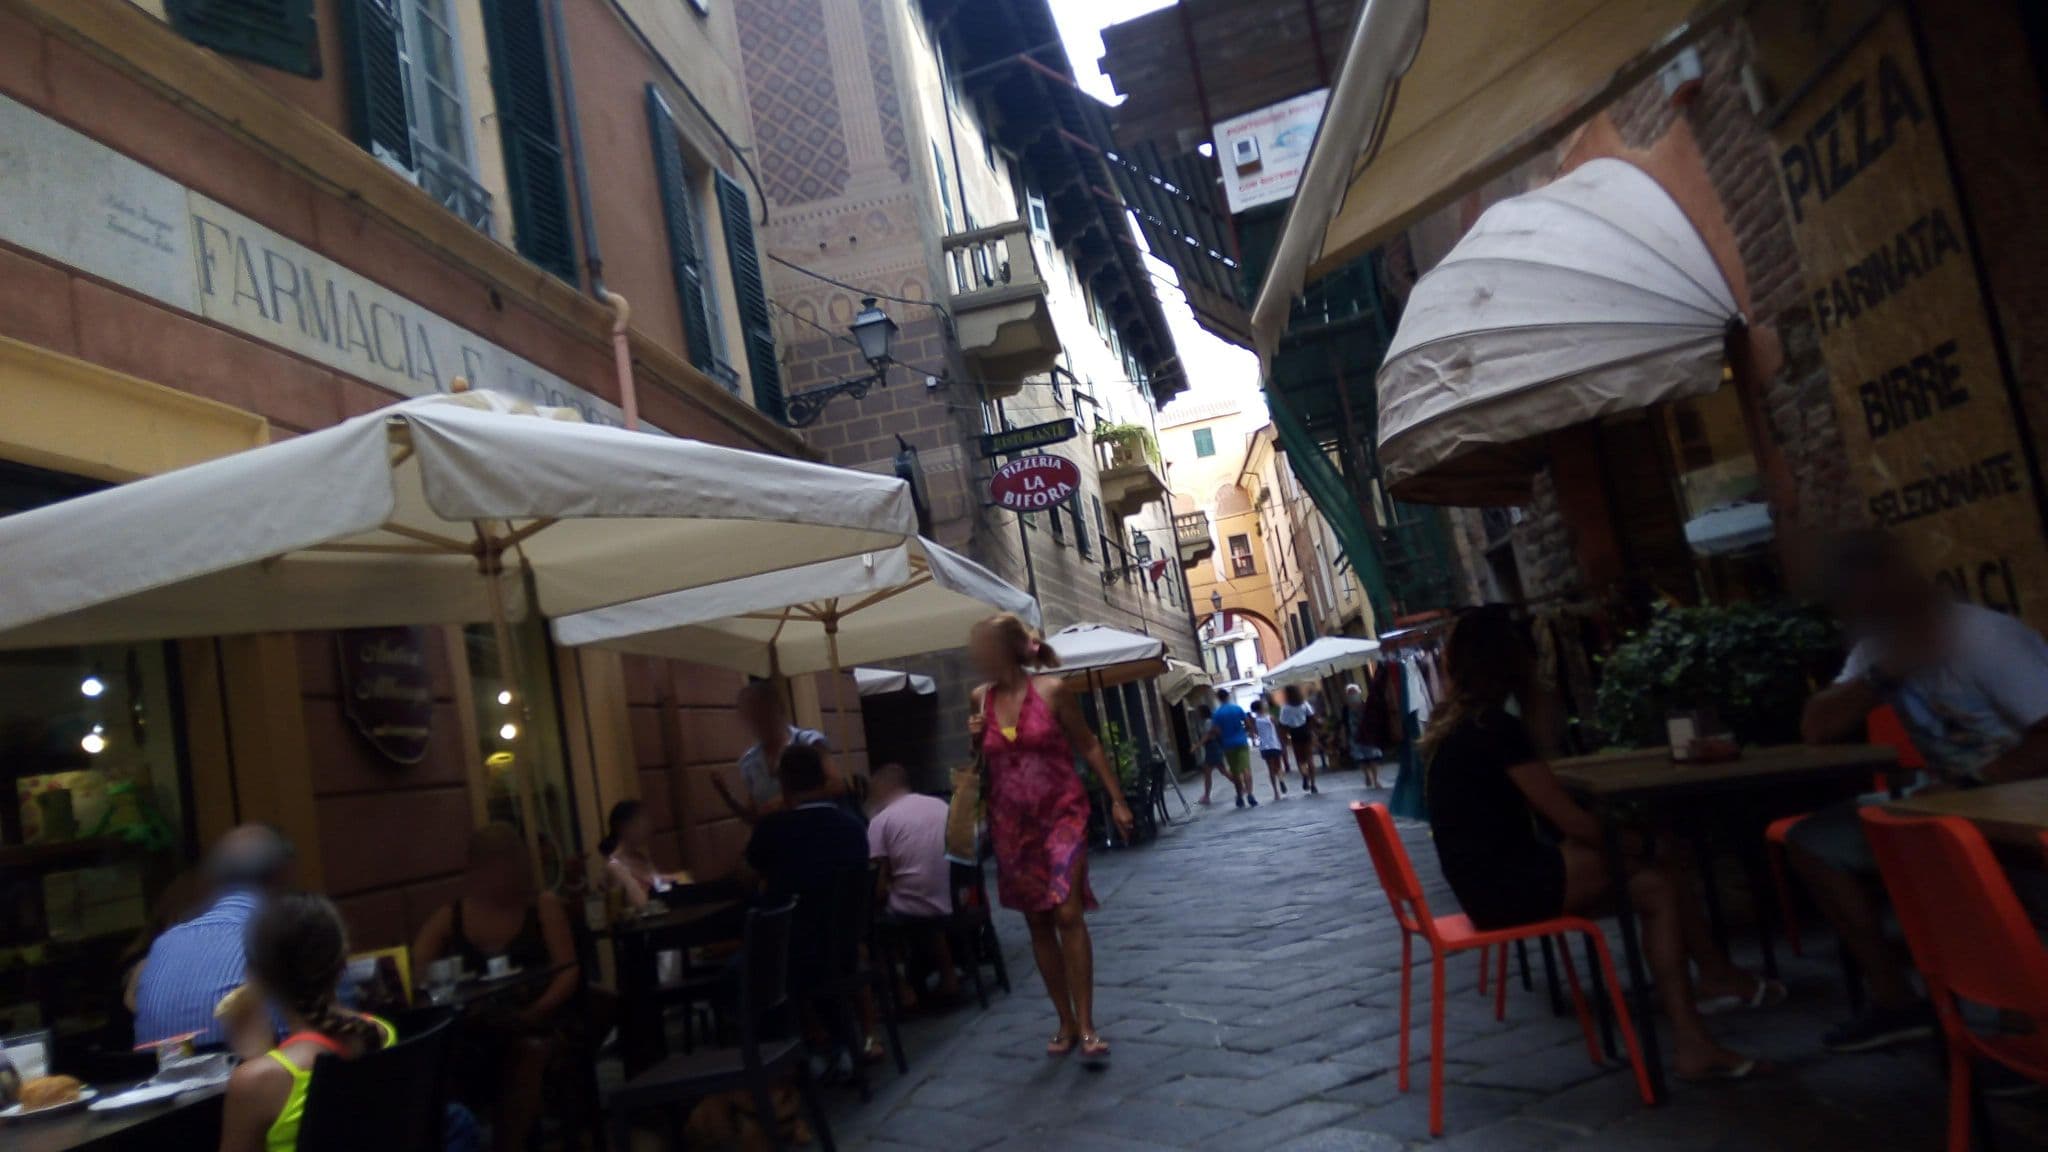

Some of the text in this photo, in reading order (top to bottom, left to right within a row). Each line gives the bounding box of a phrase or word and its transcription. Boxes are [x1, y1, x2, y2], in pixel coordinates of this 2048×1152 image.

[1780, 53, 1926, 225] PIZZA
[191, 213, 444, 394] FARMACIA
[1812, 208, 1962, 336] FARINATA
[1859, 339, 1969, 440] BIRRE
[1002, 457, 1062, 479] PIZZERIA
[1003, 482, 1071, 508] BIFORA
[1024, 475, 1046, 491] LA
[1868, 453, 2021, 527] SELEZIONATE
